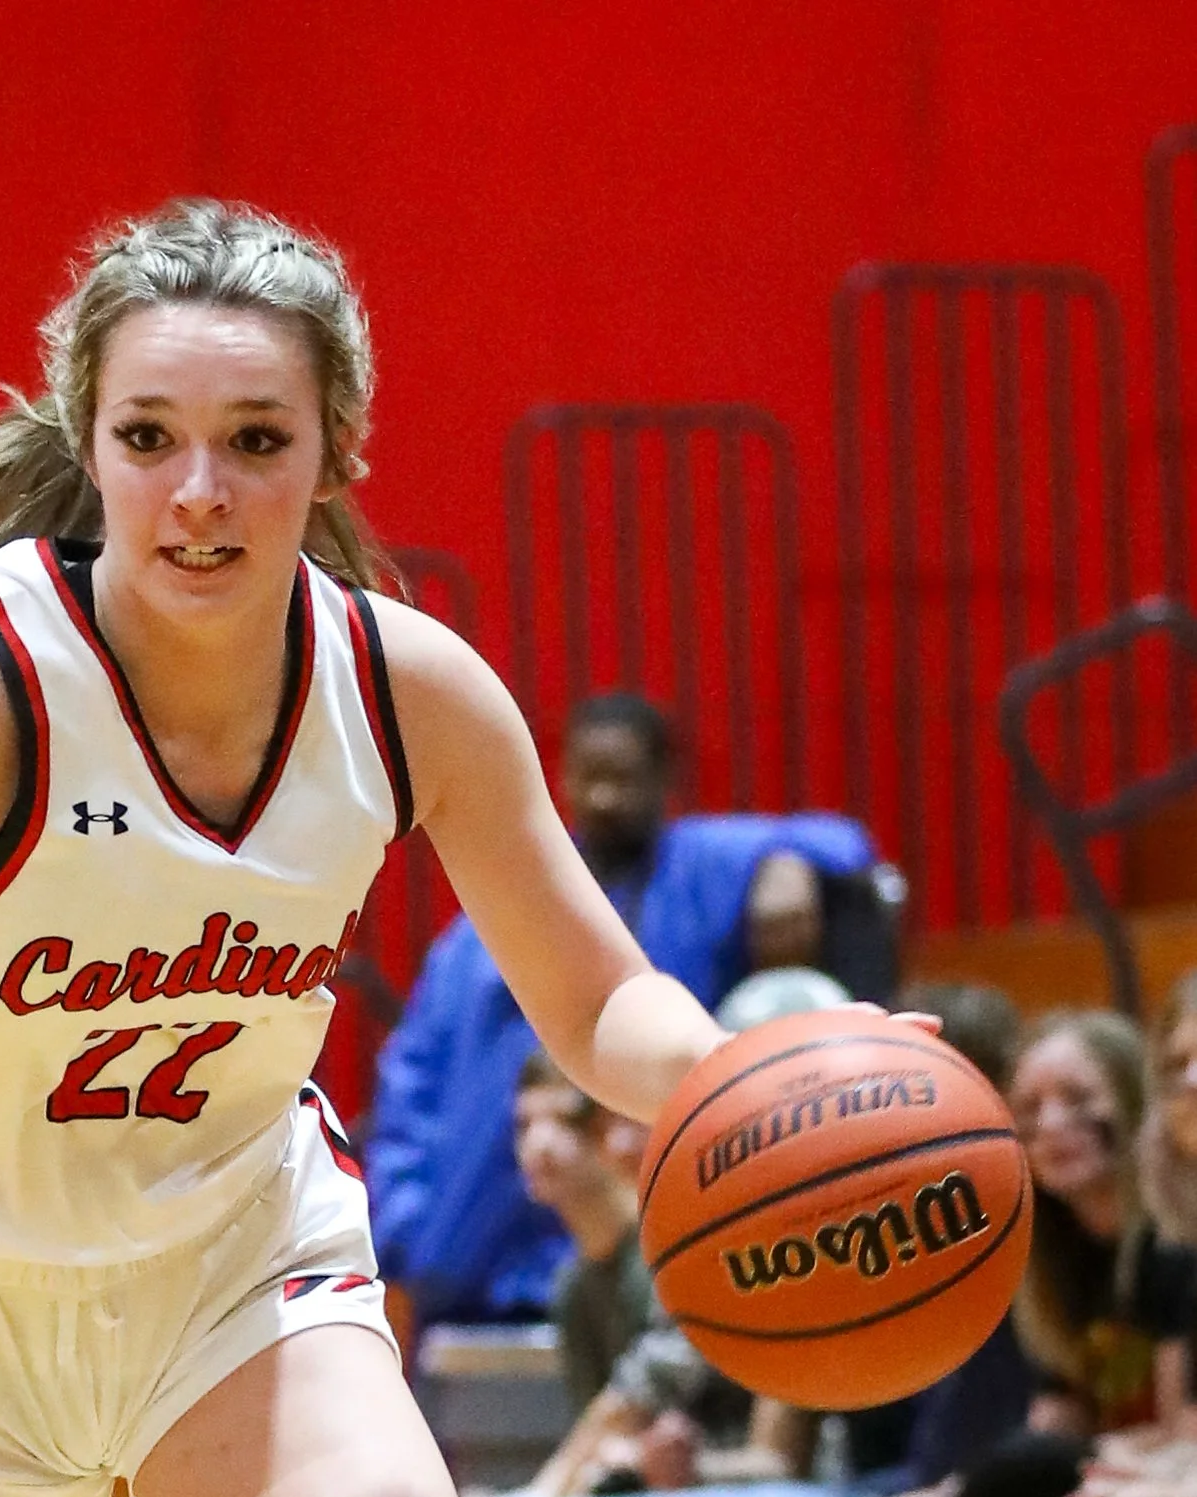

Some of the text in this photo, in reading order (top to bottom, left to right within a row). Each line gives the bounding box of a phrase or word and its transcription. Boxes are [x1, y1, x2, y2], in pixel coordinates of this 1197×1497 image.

[46, 1021, 246, 1124] 22
[695, 1075, 937, 1191] EVOLUTION
[722, 1170, 991, 1293] Wilson
